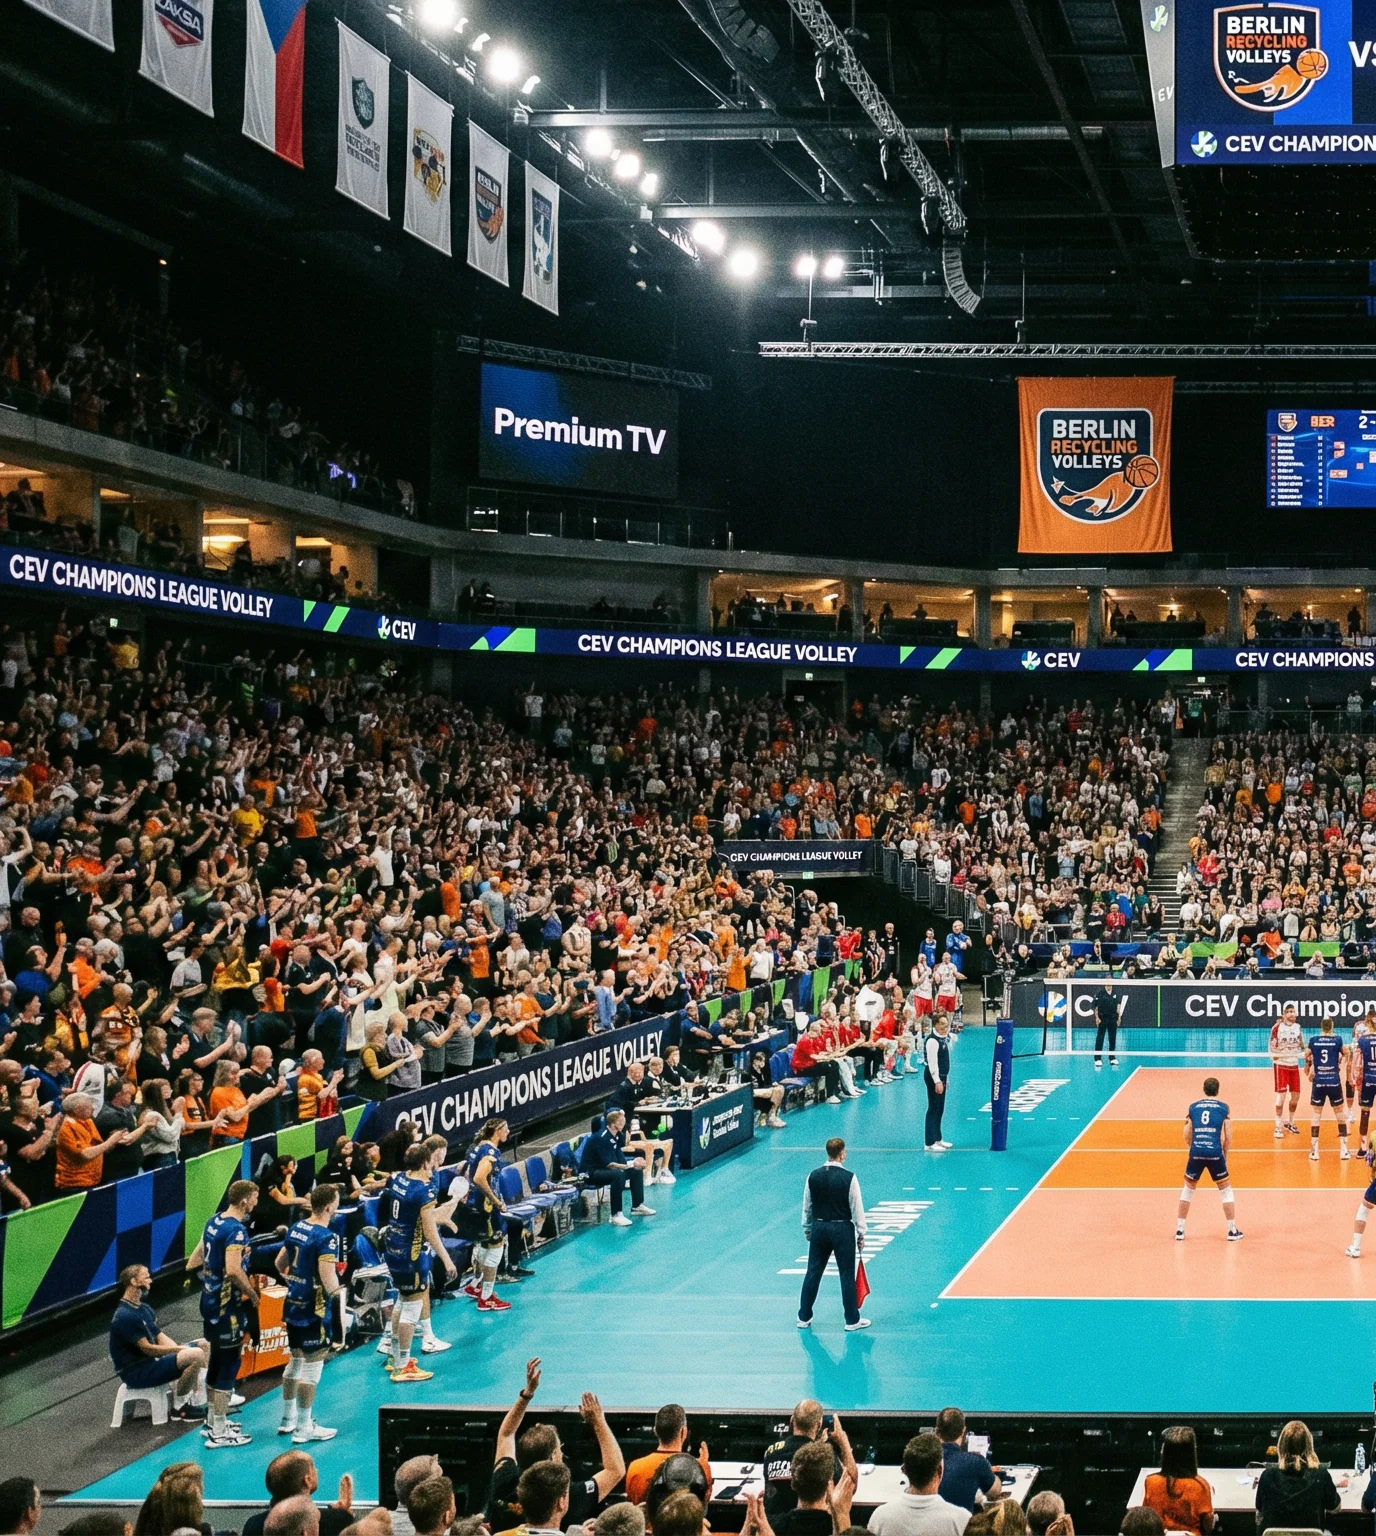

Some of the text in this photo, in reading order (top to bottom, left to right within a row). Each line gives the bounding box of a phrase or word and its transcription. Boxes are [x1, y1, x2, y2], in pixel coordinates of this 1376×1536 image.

[1227, 16, 1305, 34] BERLIN
[1226, 35, 1308, 49] RECYCLING
[1226, 50, 1292, 63] VOLLEYS
[1226, 136, 1264, 152] CEV
[494, 407, 666, 455] Premium TV
[1053, 419, 1136, 439] BERLIN
[1051, 440, 1138, 454] RECYCLING
[1052, 454, 1123, 469] VOLLEYS
[9, 553, 273, 618] CEV CHAMPIONS LEAGUE VOLLEY
[392, 620, 416, 640] CEV
[578, 634, 857, 663] CEV CHAMPIONS LEAGUE VOLLEY
[1044, 652, 1080, 667] CEV
[1236, 652, 1270, 667] CEV
[1273, 652, 1374, 667] CHAMPIONS
[1185, 995, 1239, 1017] CEV
[1321, 1049, 1328, 1063] 3
[440, 1066, 550, 1131] CHAMPIONS
[554, 1046, 612, 1092] LEAGUE
[614, 1030, 663, 1069] VOLLEY
[1201, 1110, 1210, 1125] 8
